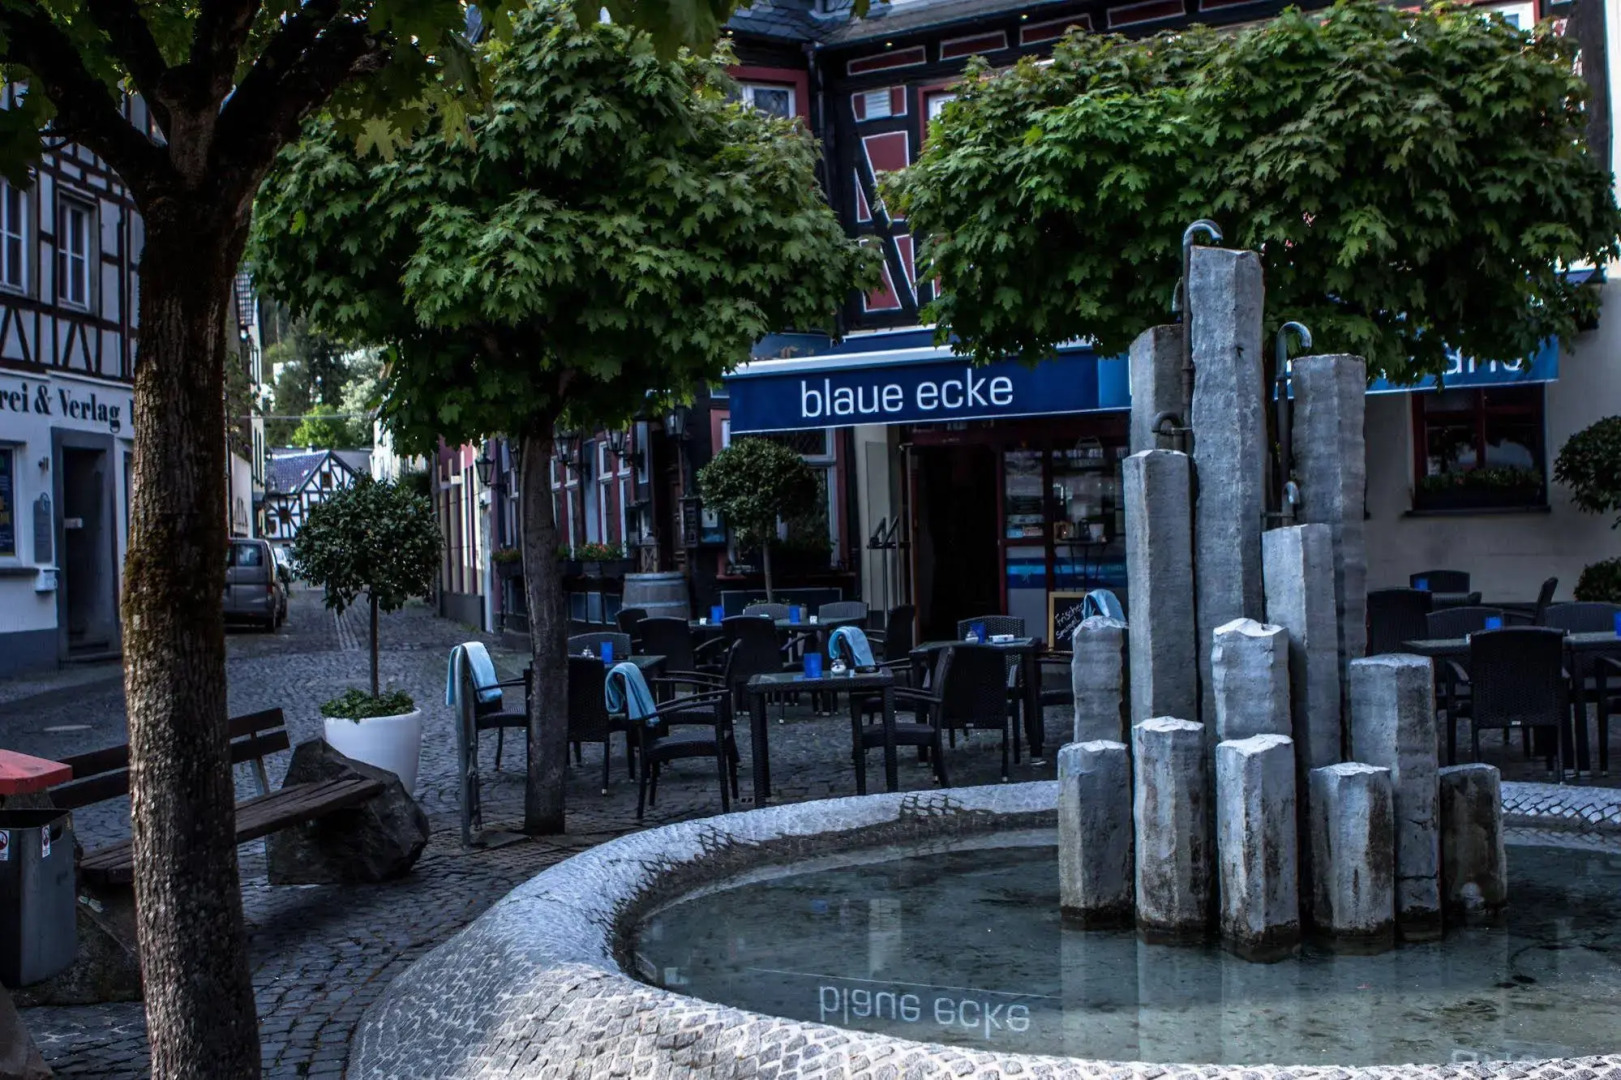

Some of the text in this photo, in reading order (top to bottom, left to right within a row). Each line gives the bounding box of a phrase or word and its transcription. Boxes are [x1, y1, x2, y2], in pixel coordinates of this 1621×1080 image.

[34, 385, 52, 415] &
[58, 388, 121, 434] Verlag
[800, 368, 1014, 418] blaue ecke
